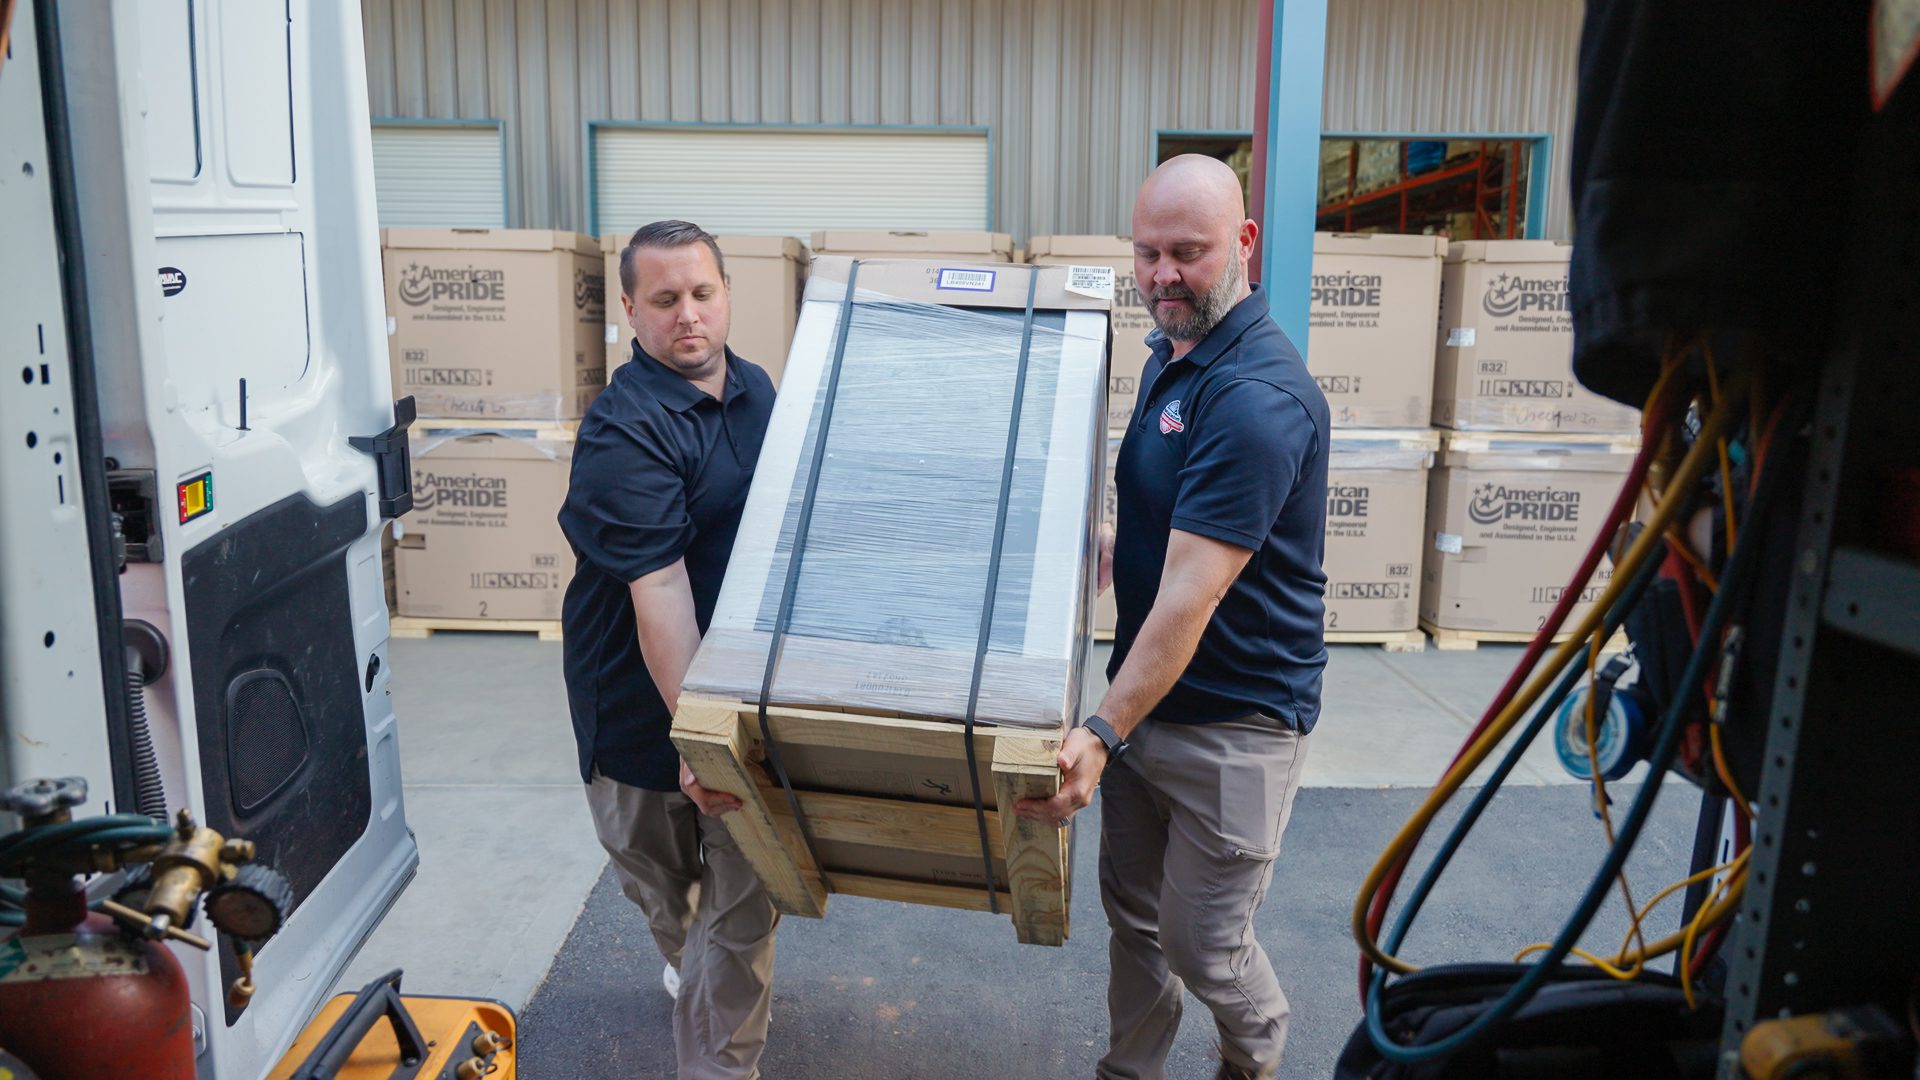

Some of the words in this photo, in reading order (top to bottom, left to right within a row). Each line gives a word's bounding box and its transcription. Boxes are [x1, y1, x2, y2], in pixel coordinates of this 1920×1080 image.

[420, 264, 504, 282] American
[1312, 270, 1382, 287] merican
[432, 281, 505, 300] PRIDE
[1509, 275, 1568, 293] Ameri
[467, 305, 506, 313] Engineered
[1309, 311, 1338, 319] esigned,
[1340, 311, 1380, 319] Engineered
[1518, 316, 1554, 324] Designed,
[1481, 363, 1504, 372] R32
[425, 472, 506, 489] American
[436, 489, 507, 507] PRIDE
[1327, 482, 1369, 498] rican
[1494, 485, 1581, 502] American
[470, 511, 508, 519] Engineered
[1328, 499, 1368, 517] IDE
[1504, 502, 1579, 522] PRIDE
[1502, 523, 1537, 532] Designed,
[1539, 525, 1578, 533] Engineered
[1494, 532, 1534, 540] Assembled
[1544, 533, 1556, 541] the
[1556, 534, 1577, 542] U.S.A.
[1389, 566, 1409, 576] R32
[479, 601, 488, 617] 2
[1328, 611, 1338, 628] 2
[1537, 615, 1546, 631] 2
